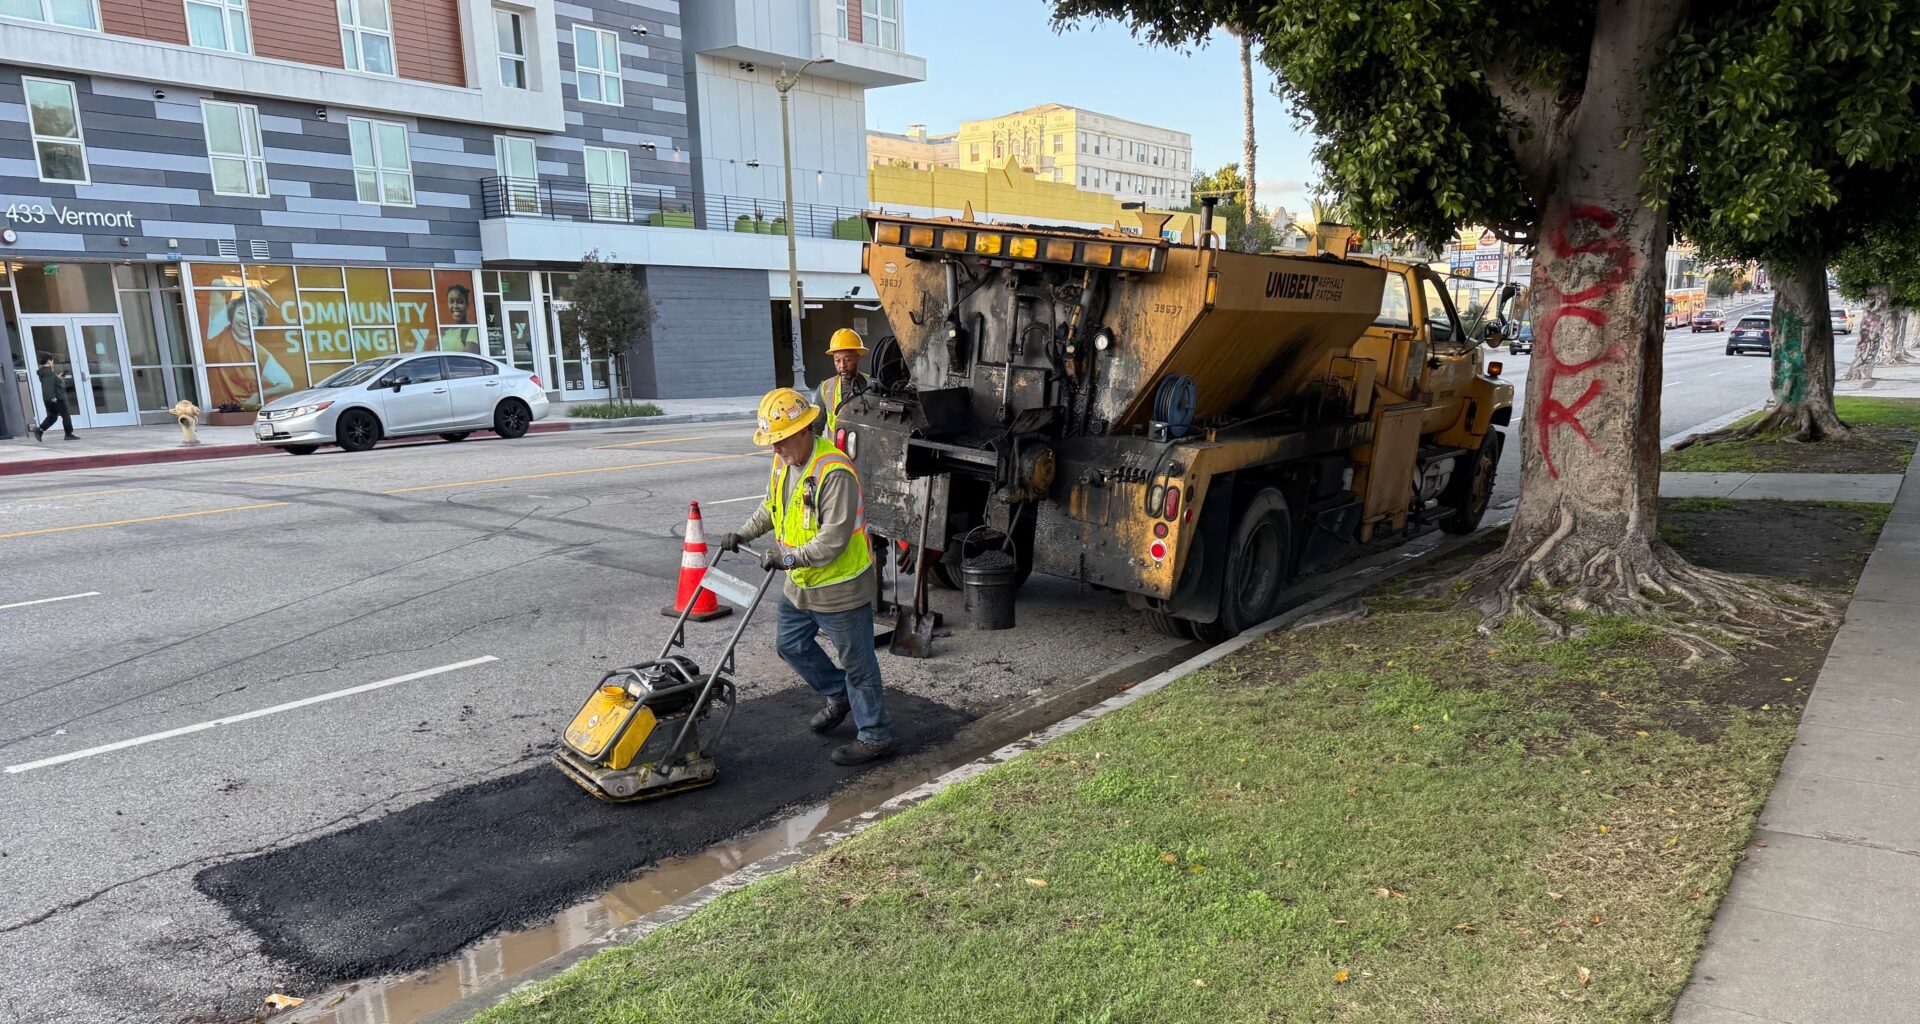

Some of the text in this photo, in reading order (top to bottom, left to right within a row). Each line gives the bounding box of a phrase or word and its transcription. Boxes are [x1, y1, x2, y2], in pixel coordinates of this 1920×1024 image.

[5, 203, 135, 228] 433 Vermont
[1265, 271, 1319, 300] UNIBELT
[1317, 276, 1345, 289] ASPHALT
[1315, 289, 1343, 302] PATCHER
[280, 301, 428, 325] COMMUNITY
[284, 328, 396, 353] STRONG!
